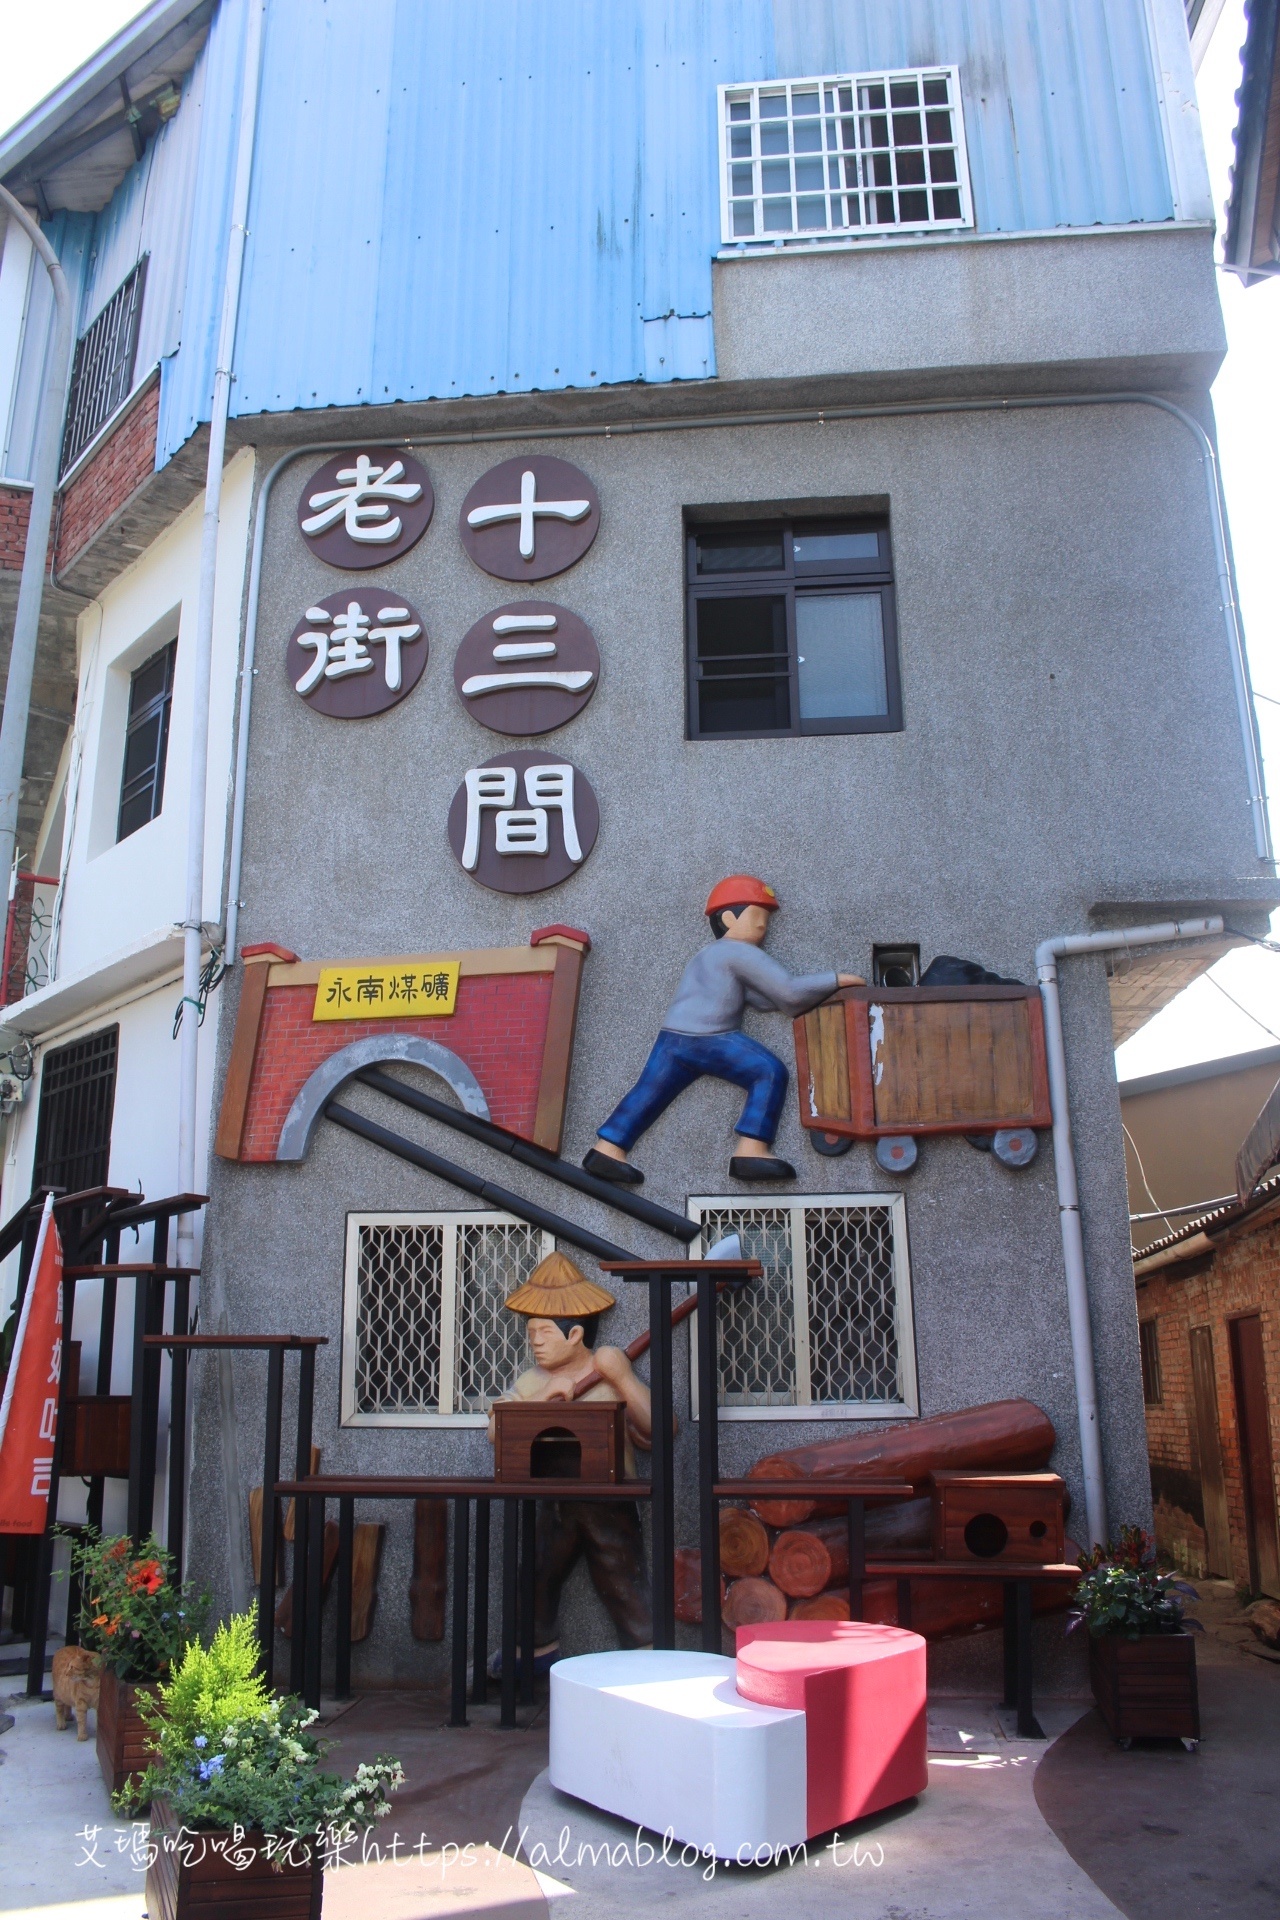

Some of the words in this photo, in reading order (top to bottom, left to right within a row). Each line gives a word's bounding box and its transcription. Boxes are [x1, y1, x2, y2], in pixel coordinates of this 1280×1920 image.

[295, 454, 423, 696] 老街
[460, 470, 594, 873] 十三間
[325, 971, 450, 1009] 永南煤礦
